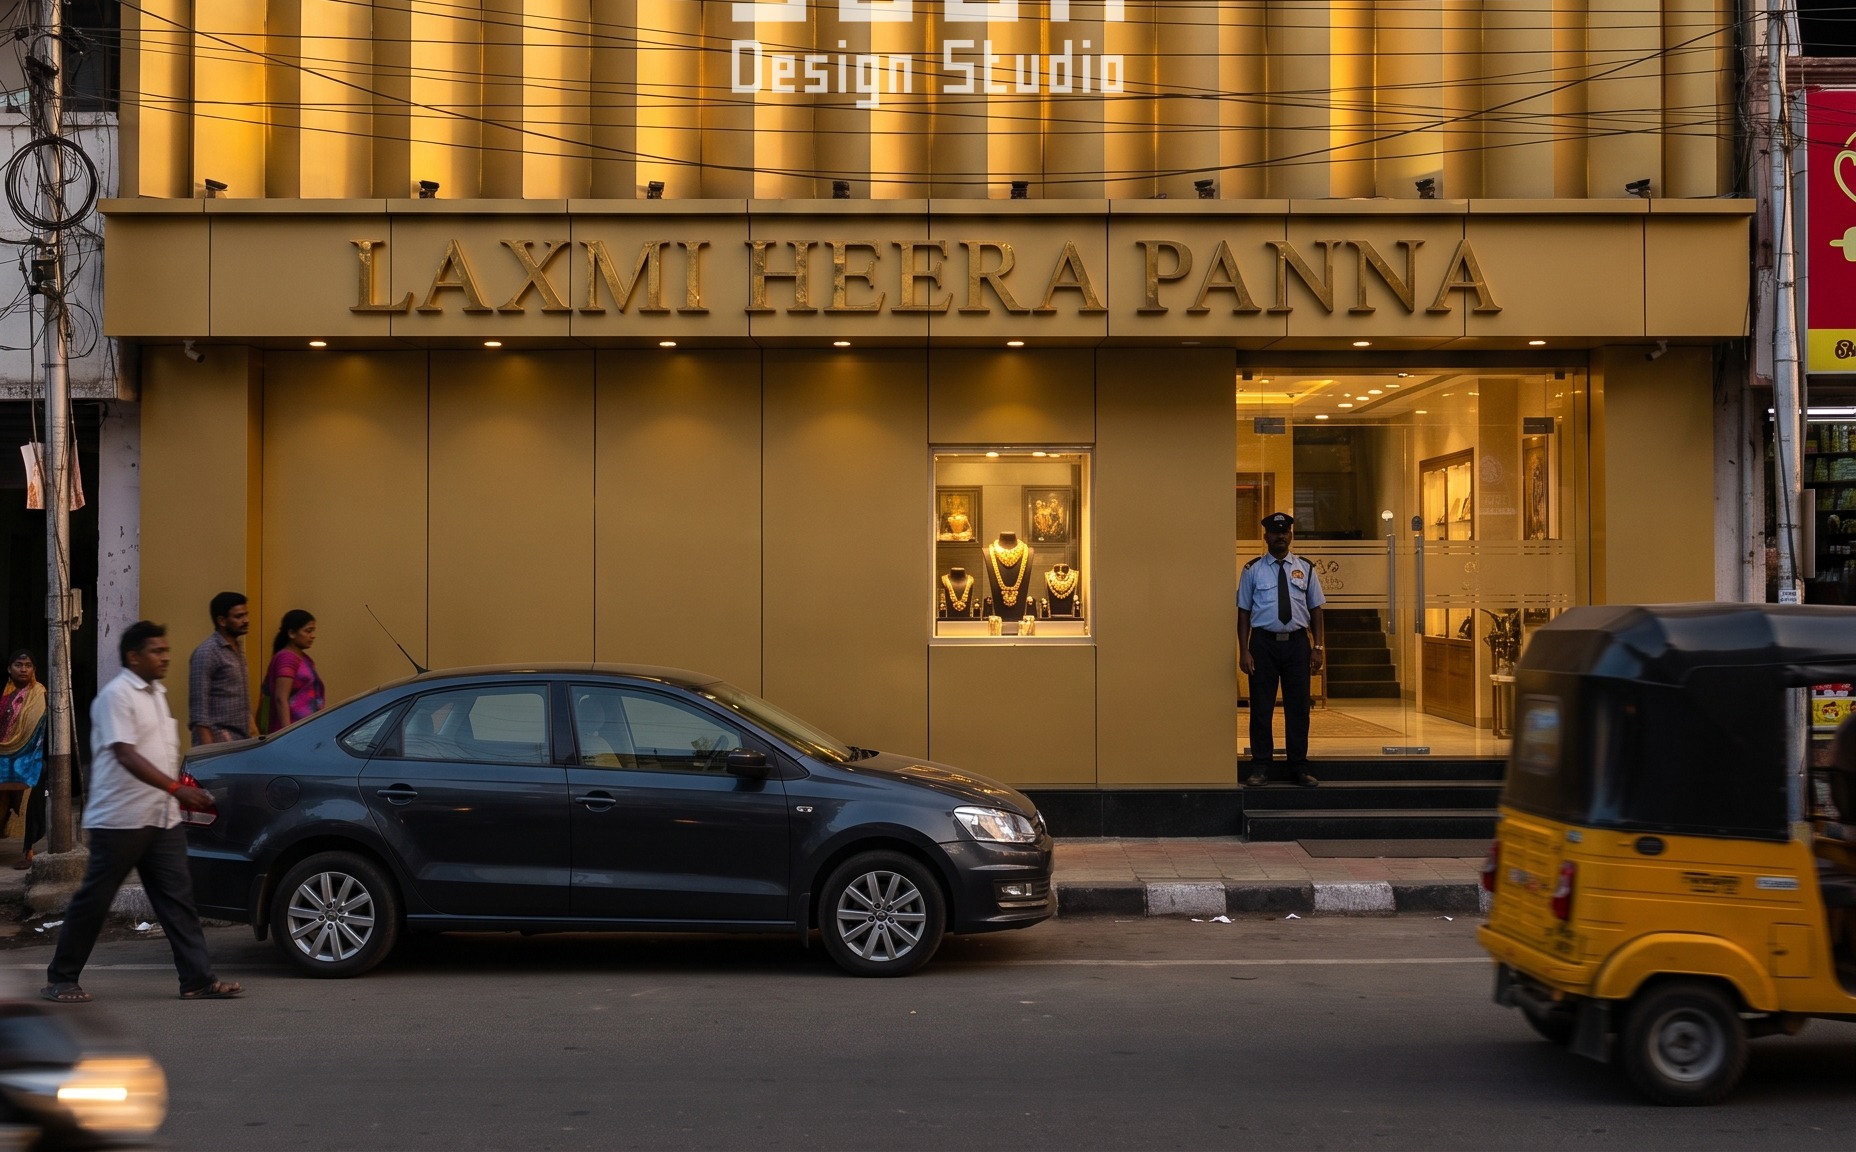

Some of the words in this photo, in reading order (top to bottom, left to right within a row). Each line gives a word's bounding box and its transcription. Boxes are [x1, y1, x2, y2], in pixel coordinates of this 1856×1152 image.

[349, 239, 710, 314] LAXMI
[744, 239, 1109, 314] HEERA
[1135, 239, 1504, 314] PANNA
